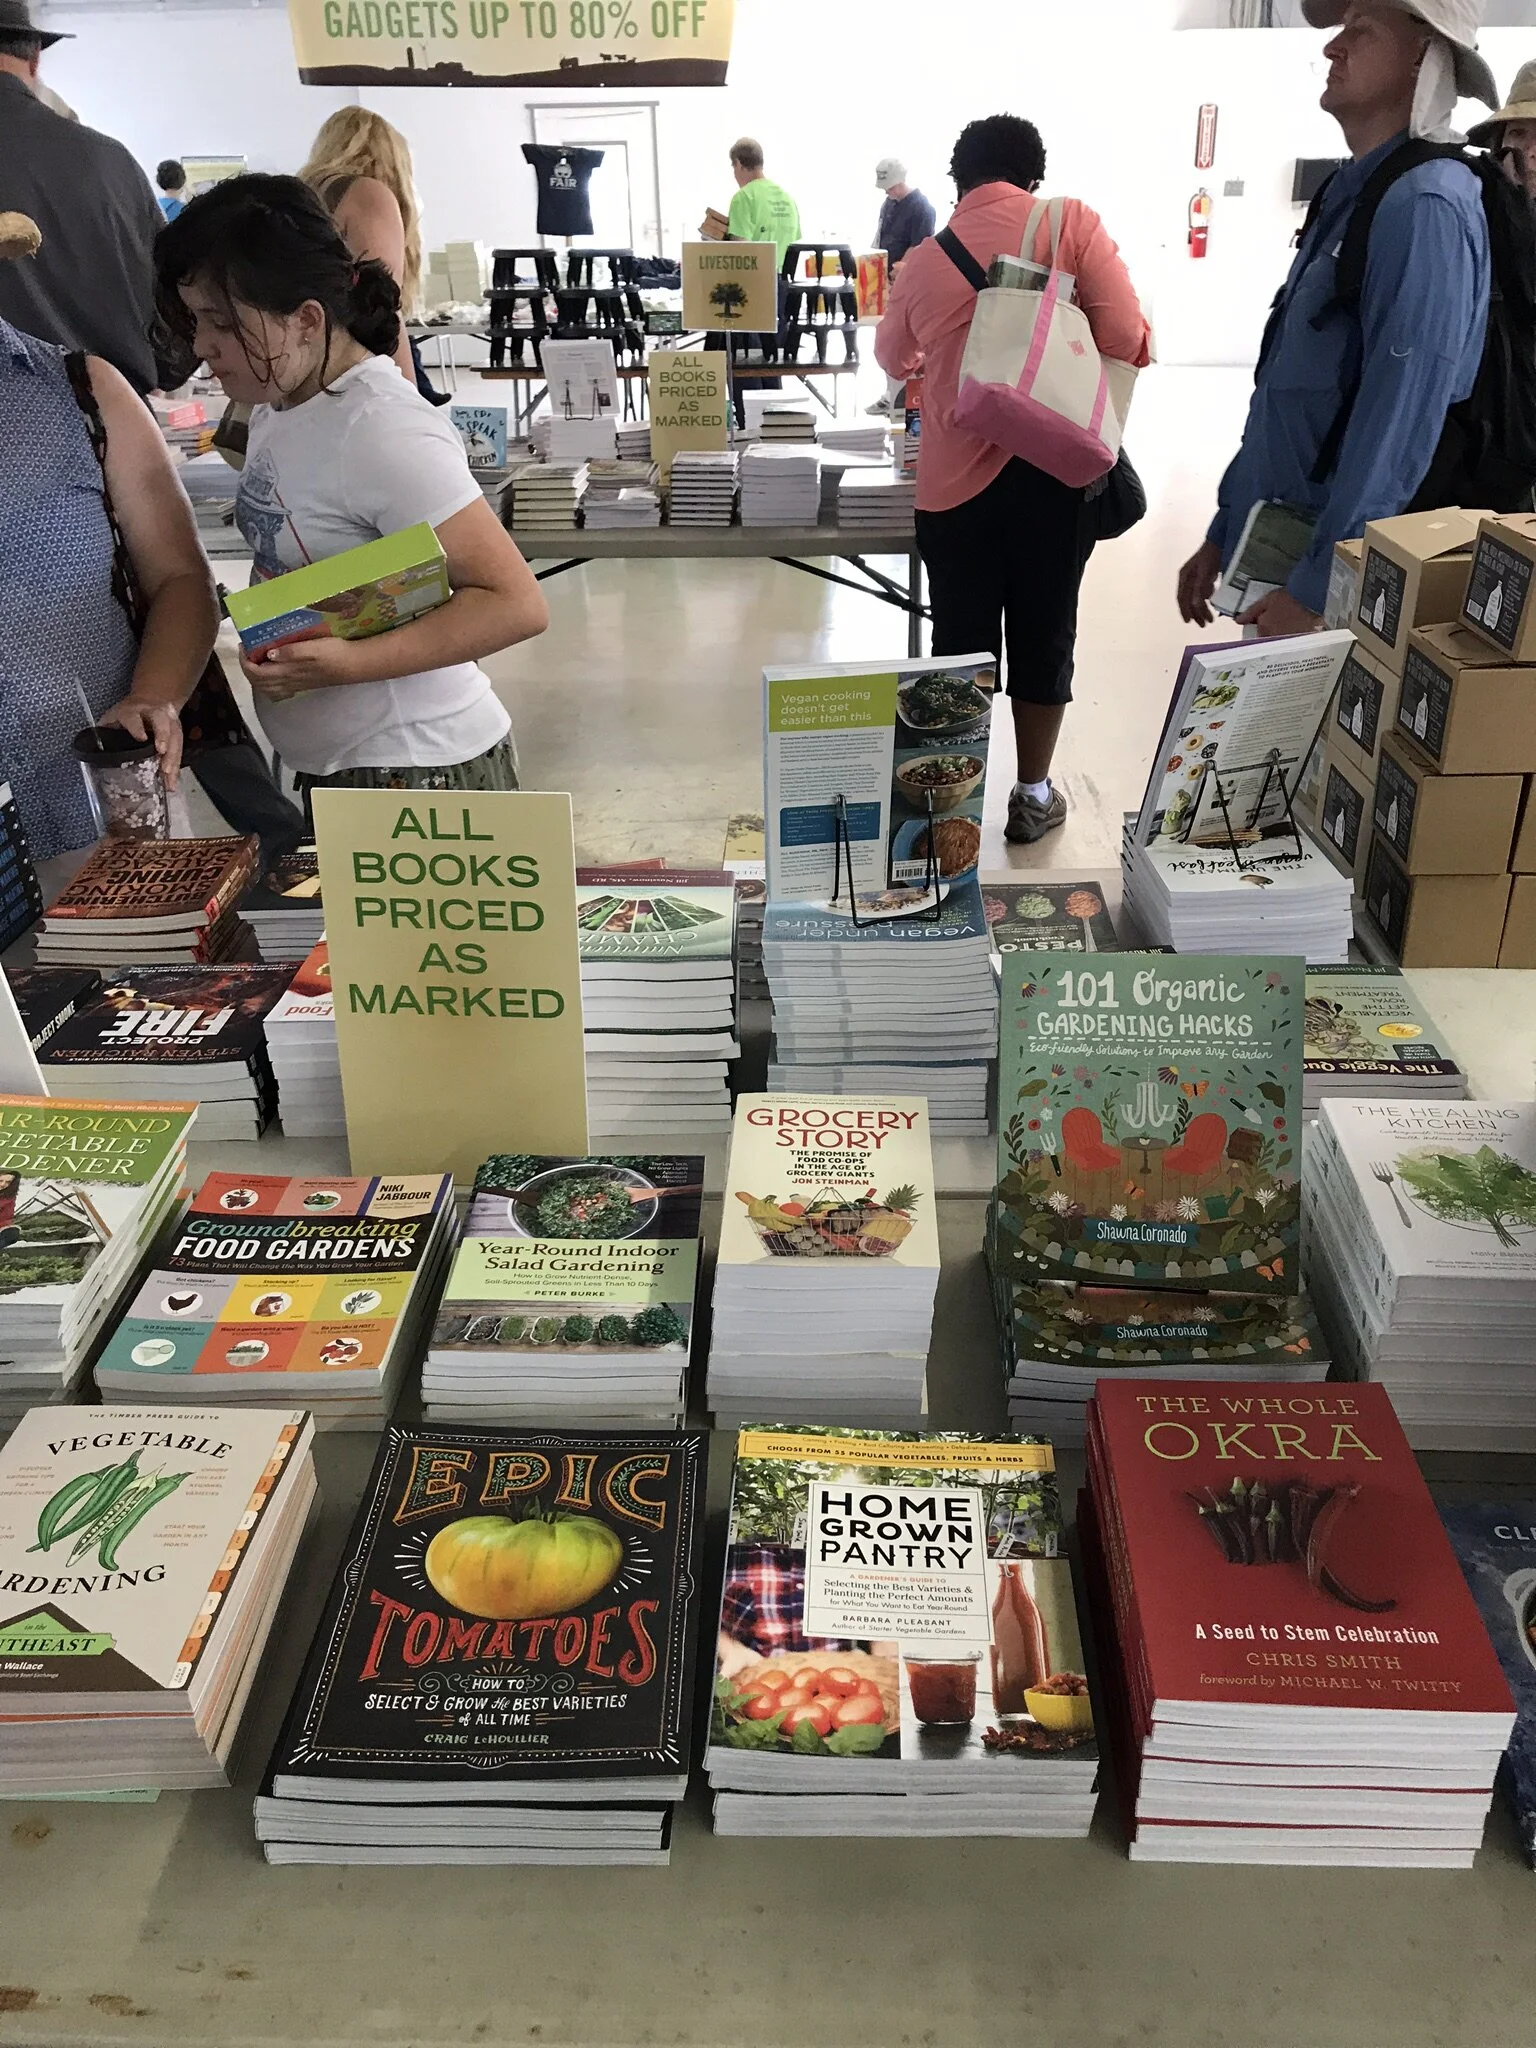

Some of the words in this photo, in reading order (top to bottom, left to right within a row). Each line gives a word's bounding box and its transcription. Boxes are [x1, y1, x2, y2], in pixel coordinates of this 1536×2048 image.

[324, 0, 458, 38] GADGETS
[471, 0, 507, 39] UP
[525, 0, 558, 39] TO
[570, 1, 638, 39] 80%
[651, 2, 705, 40] OFF
[550, 177, 577, 188] FAIR
[699, 256, 758, 270] LIVESTOCK
[672, 357, 702, 367] ALL
[659, 371, 716, 382] BOOKS
[659, 386, 717, 397] PRICED
[677, 401, 699, 412] AS
[655, 416, 722, 427] MARKED
[466, 421, 498, 440] SPEAK
[781, 695, 819, 704] Vegan
[823, 690, 871, 701] cooking
[781, 704, 825, 714] doesn't
[830, 703, 849, 713] get
[781, 715, 816, 725] easier
[820, 714, 846, 723] than
[850, 712, 872, 721] this
[391, 807, 494, 841] ALL
[87, 855, 232, 871] SAUSAGE
[353, 852, 540, 888] BOOKS
[106, 866, 225, 885] CURING
[65, 881, 213, 897] SMOKING
[57, 893, 208, 906] BUTCHERING
[355, 897, 545, 932] PRICED
[775, 919, 893, 930] pessure
[890, 925, 975, 938] vegan
[797, 928, 878, 938] under
[998, 939, 1083, 953] PESTO
[418, 943, 488, 974] AS
[1056, 970, 1119, 1008] 101
[1133, 968, 1246, 1011] Organic
[348, 983, 565, 1019] MARKED
[284, 1006, 333, 1018] Food
[30, 1022, 56, 1051] ROJECT
[54, 1000, 76, 1029] SMOKE
[97, 1008, 236, 1037] FIRE
[1037, 1012, 1174, 1037] GARDENING
[1179, 1014, 1254, 1037] HACKS
[101, 1036, 204, 1046] PROJECT
[50, 1047, 157, 1059] RAICHLEN
[160, 1046, 242, 1057] STEVEN
[1030, 1042, 1094, 1055] Eco-friendly
[1096, 1044, 1140, 1057] Solutions
[1144, 1044, 1155, 1057] to
[1158, 1046, 1202, 1058] Improve
[1205, 1048, 1228, 1058] any
[1232, 1049, 1273, 1059] Garden
[1338, 1061, 1402, 1074] Veggie
[1405, 1064, 1443, 1074] The
[747, 1108, 919, 1129] GROCERY
[1352, 1106, 1402, 1117] THE
[1410, 1107, 1520, 1119] HEALING
[1387, 1118, 1497, 1130] KITCHEN
[776, 1129, 888, 1149] STORY
[376, 1192, 432, 1201] JABBOUR
[187, 1220, 420, 1241] Groundbreaking
[1097, 1221, 1139, 1241] Shawna
[1141, 1223, 1187, 1243] Coronado
[173, 1236, 261, 1260] FOOD
[265, 1238, 416, 1260] GARDENS
[478, 1242, 602, 1256] Year-Round
[607, 1245, 679, 1257] Indoor
[485, 1257, 543, 1270] Salad
[549, 1258, 664, 1274] Gardening
[1116, 1326, 1159, 1339] Shawna
[1161, 1324, 1208, 1337] Coronado
[1137, 1396, 1210, 1413] THE
[1220, 1398, 1359, 1415] WHOLE
[48, 1431, 233, 1459] VEGETABLE
[1144, 1421, 1383, 1460] OKRA
[849, 1451, 890, 1459] POPULAR
[893, 1453, 949, 1462] VEGETABLES,
[393, 1447, 671, 1532] EPIC
[821, 1490, 972, 1522] HOME
[820, 1518, 973, 1544] GROWN
[820, 1540, 973, 1570] PANTRY
[0, 1565, 166, 1595] RDENING
[824, 1579, 870, 1590] Selecting
[873, 1582, 890, 1590] the
[892, 1583, 914, 1592] Best
[917, 1584, 961, 1593] Varieties
[964, 1586, 973, 1594] &
[824, 1588, 866, 1599] Planting
[868, 1591, 885, 1599] the
[888, 1592, 924, 1601] Perfect
[927, 1594, 973, 1603] Amounts
[842, 1599, 863, 1607] What
[842, 1615, 891, 1624] BARBARA
[897, 1618, 952, 1626] PLEASANT
[358, 1589, 660, 1686] TOMATOES
[896, 1626, 932, 1634] Vegetable
[1196, 1623, 1207, 1639] A
[1213, 1624, 1255, 1640] Seed
[1261, 1625, 1279, 1641] to
[1286, 1625, 1331, 1642] Stem
[1337, 1625, 1440, 1645] Celebration
[0, 1638, 96, 1652] THEAST
[4, 1661, 44, 1670] Wallace
[1247, 1652, 1317, 1668] CHRIS
[1326, 1654, 1402, 1671] SMITH
[472, 1679, 501, 1690] HOW
[507, 1679, 525, 1690] TO
[1200, 1673, 1257, 1687] foreword
[1260, 1675, 1275, 1688] by
[1281, 1675, 1362, 1689] MICHAEL
[1365, 1679, 1386, 1690] W.
[1392, 1679, 1462, 1694] TWITTY
[365, 1694, 424, 1711] SELECT
[425, 1694, 440, 1711] &
[444, 1695, 488, 1711] GROW
[491, 1697, 511, 1711] the
[512, 1696, 550, 1711] BEST
[552, 1694, 628, 1711] VARIETIES
[458, 1712, 471, 1726] of
[475, 1714, 497, 1725] ALL
[500, 1713, 531, 1725] TIME
[424, 1733, 469, 1744] CRAIG
